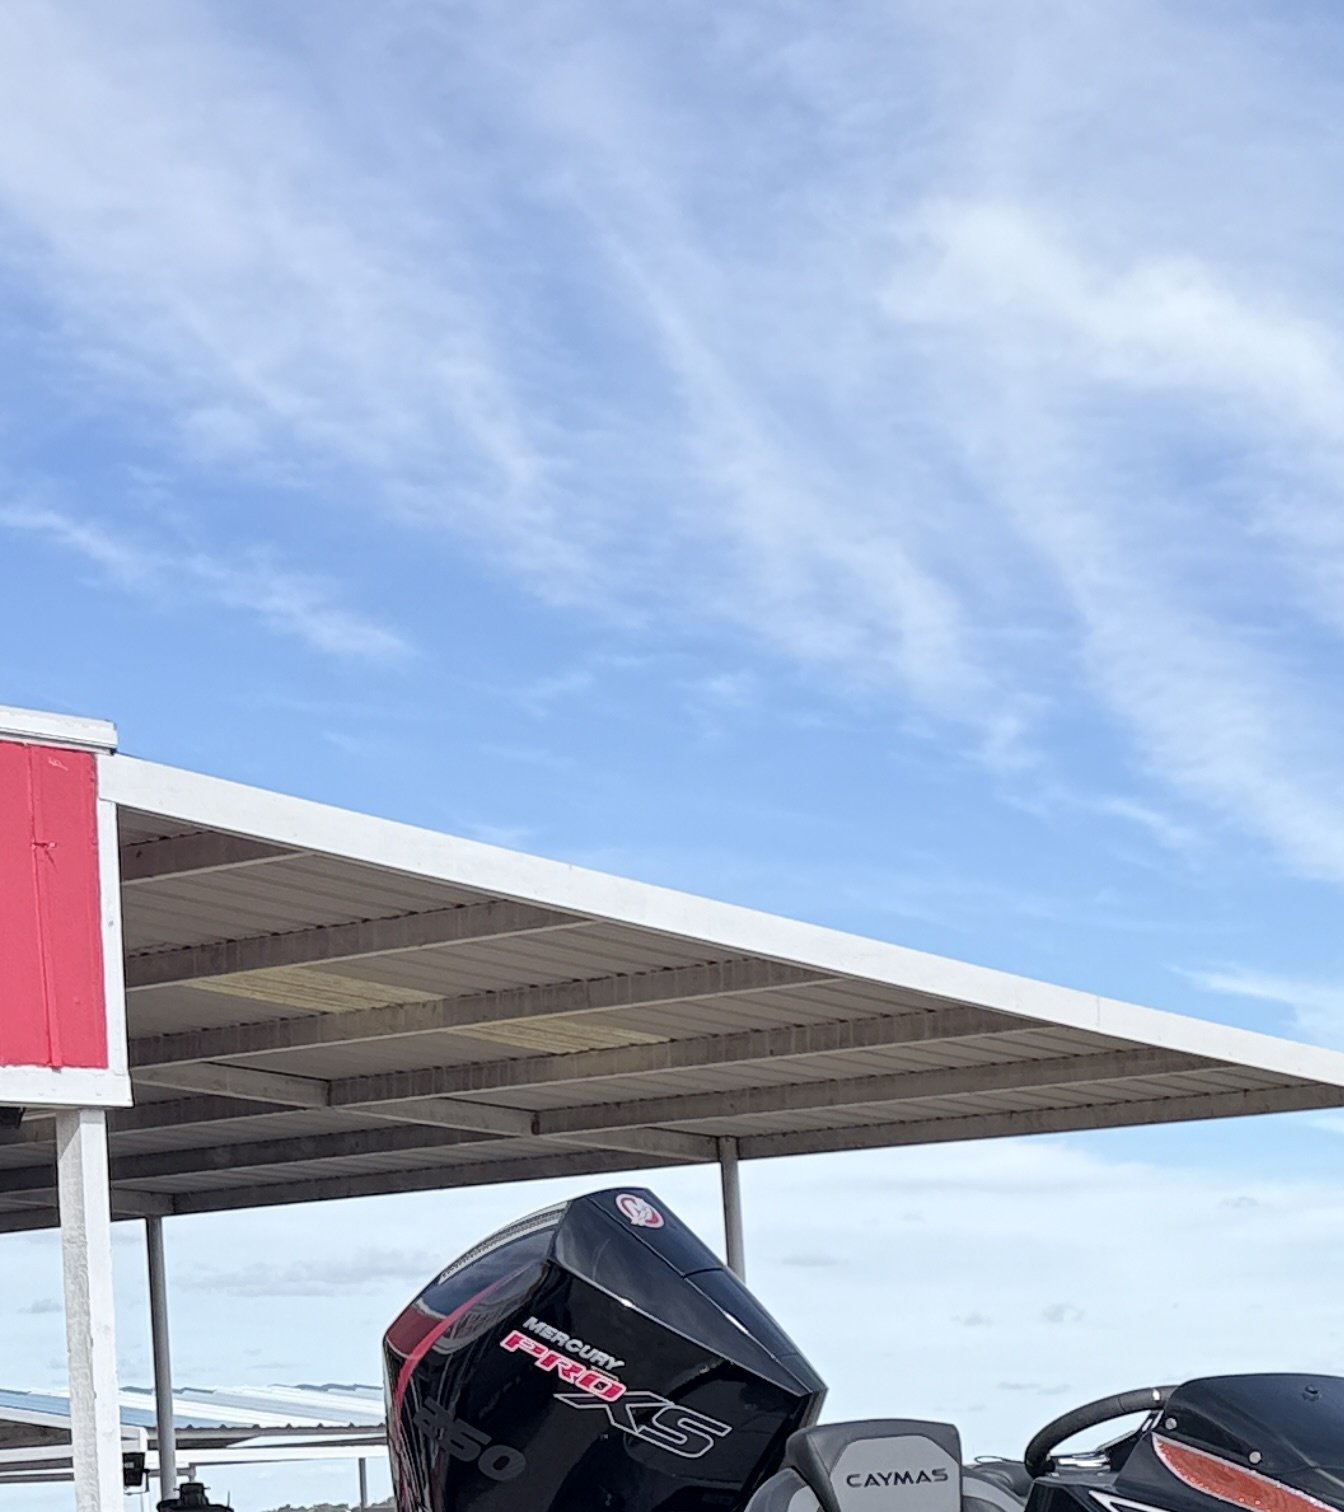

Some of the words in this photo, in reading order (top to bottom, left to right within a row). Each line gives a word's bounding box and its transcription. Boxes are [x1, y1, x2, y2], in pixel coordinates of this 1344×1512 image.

[500, 1330, 627, 1402] PRO
[522, 1316, 625, 1371] MERCURY
[553, 1391, 732, 1459] XS
[846, 1467, 949, 1488] CAYMAS
